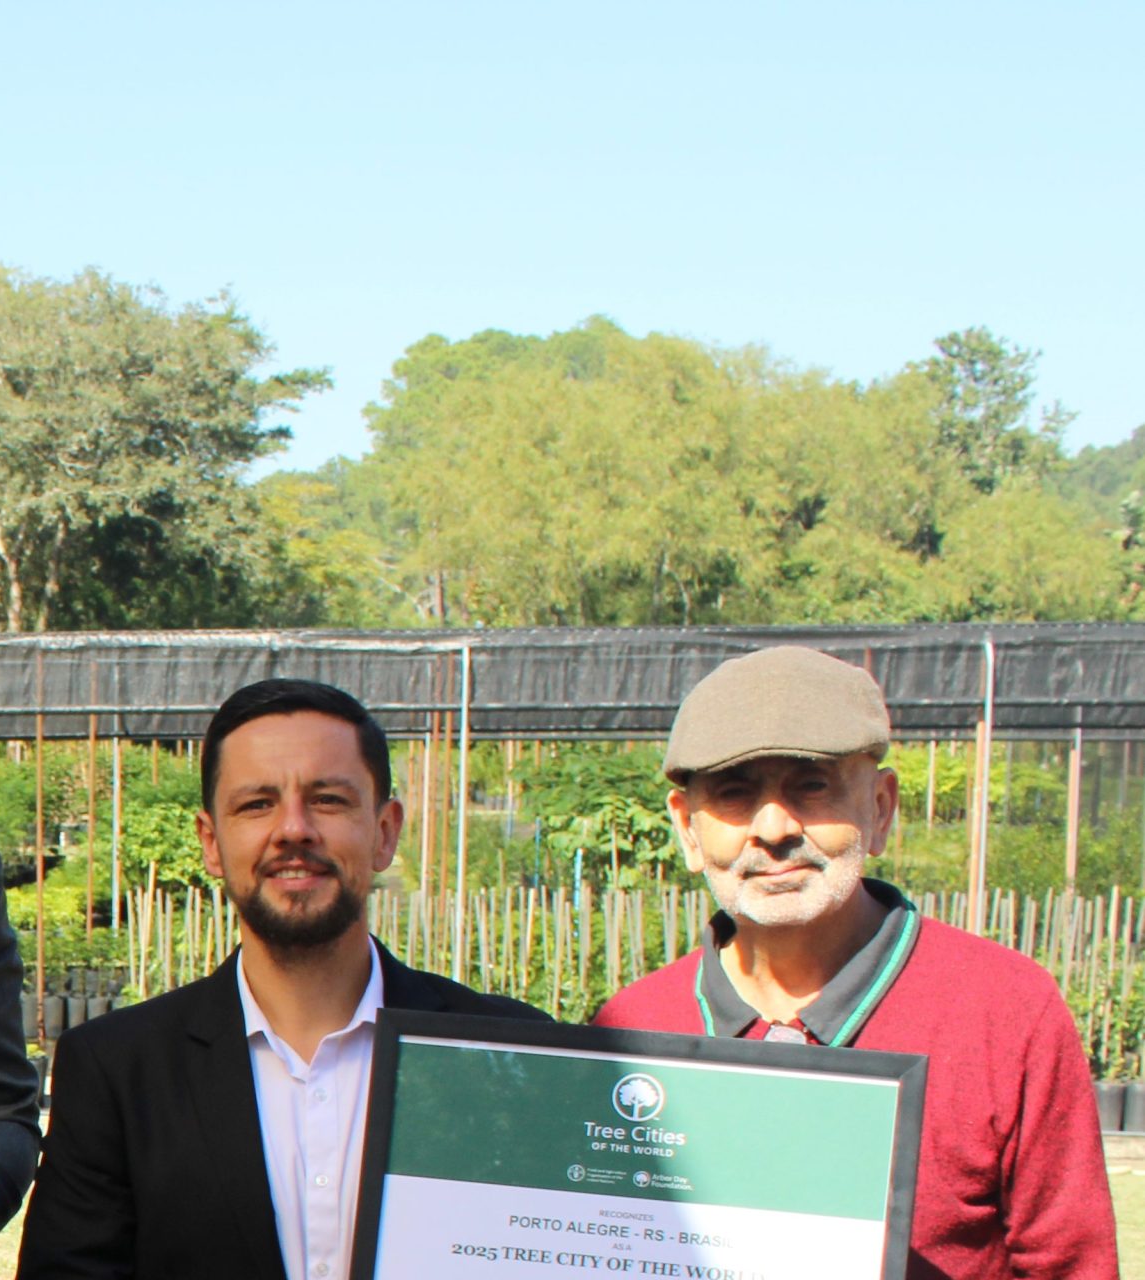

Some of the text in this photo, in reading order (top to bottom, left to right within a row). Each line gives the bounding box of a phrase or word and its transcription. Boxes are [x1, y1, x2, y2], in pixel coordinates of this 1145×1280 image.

[584, 1121, 687, 1146] Tree Cities
[591, 1142, 674, 1158] OF THE WORLD
[599, 1209, 655, 1222] RECOGNIZES
[508, 1215, 562, 1231] PORTO
[566, 1221, 630, 1238] ALEGRE
[643, 1228, 664, 1242] RS
[678, 1231, 734, 1248] BRASIL
[611, 1242, 625, 1250] AS
[451, 1243, 498, 1261] 2025
[501, 1246, 553, 1264] TREE
[556, 1252, 605, 1269] CITY
[607, 1257, 635, 1272] OF
[638, 1260, 681, 1277] THE
